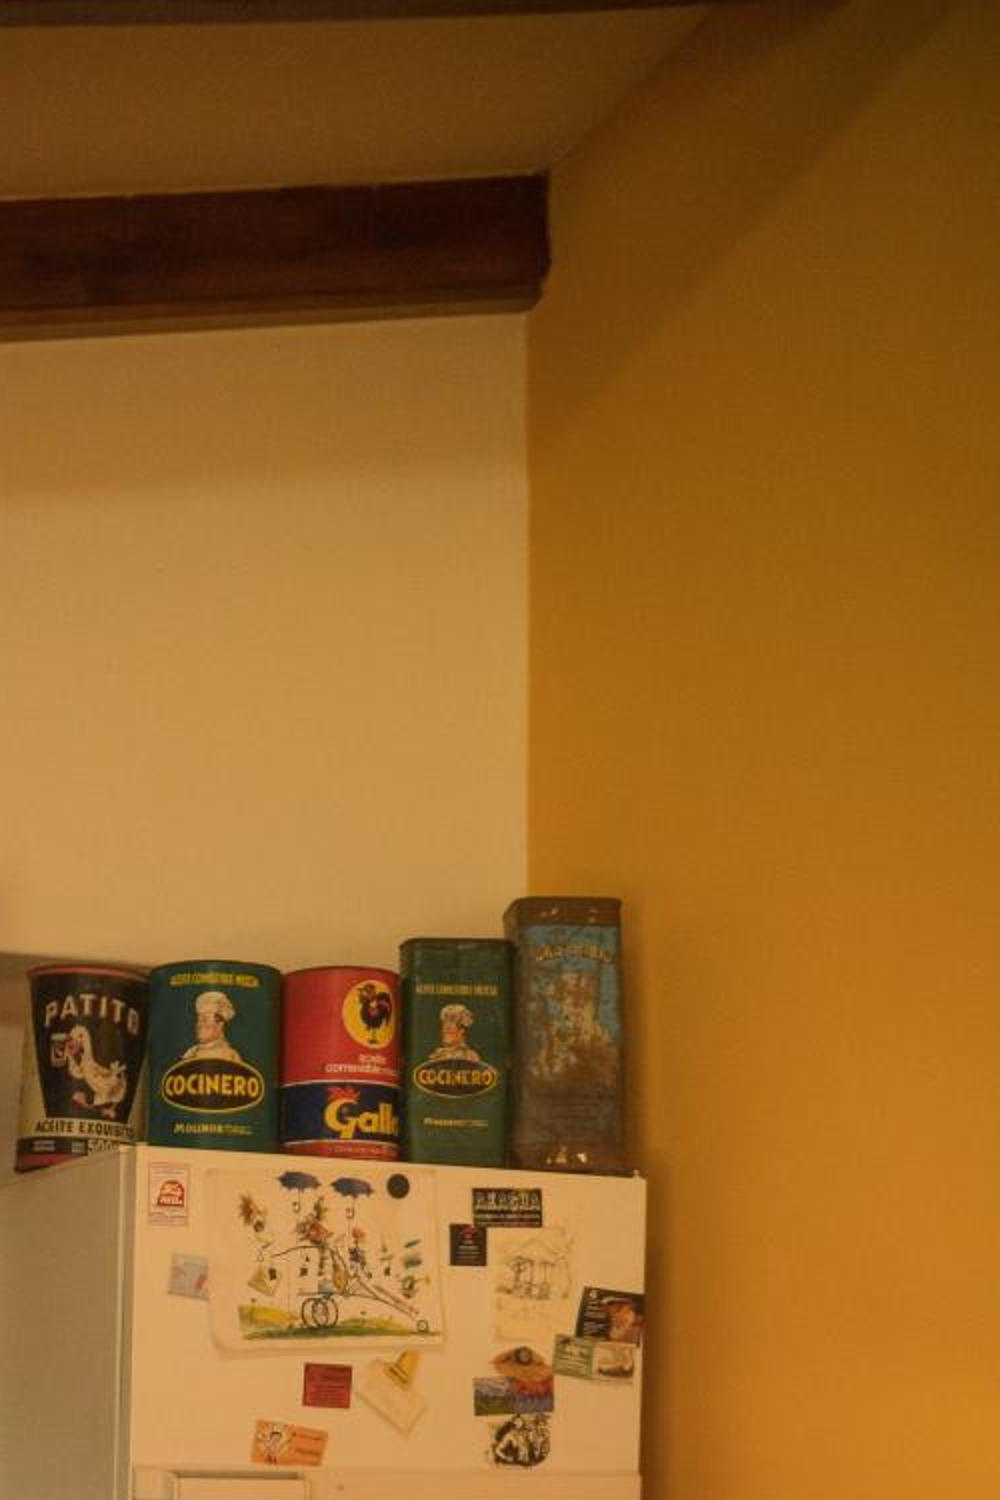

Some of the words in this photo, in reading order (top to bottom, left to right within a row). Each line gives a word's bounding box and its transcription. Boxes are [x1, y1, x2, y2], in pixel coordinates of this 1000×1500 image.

[44, 993, 140, 1036] PATITO
[164, 1074, 260, 1097] COCINERO
[419, 1068, 493, 1085] COCINERO
[35, 1119, 74, 1134] ACEITE
